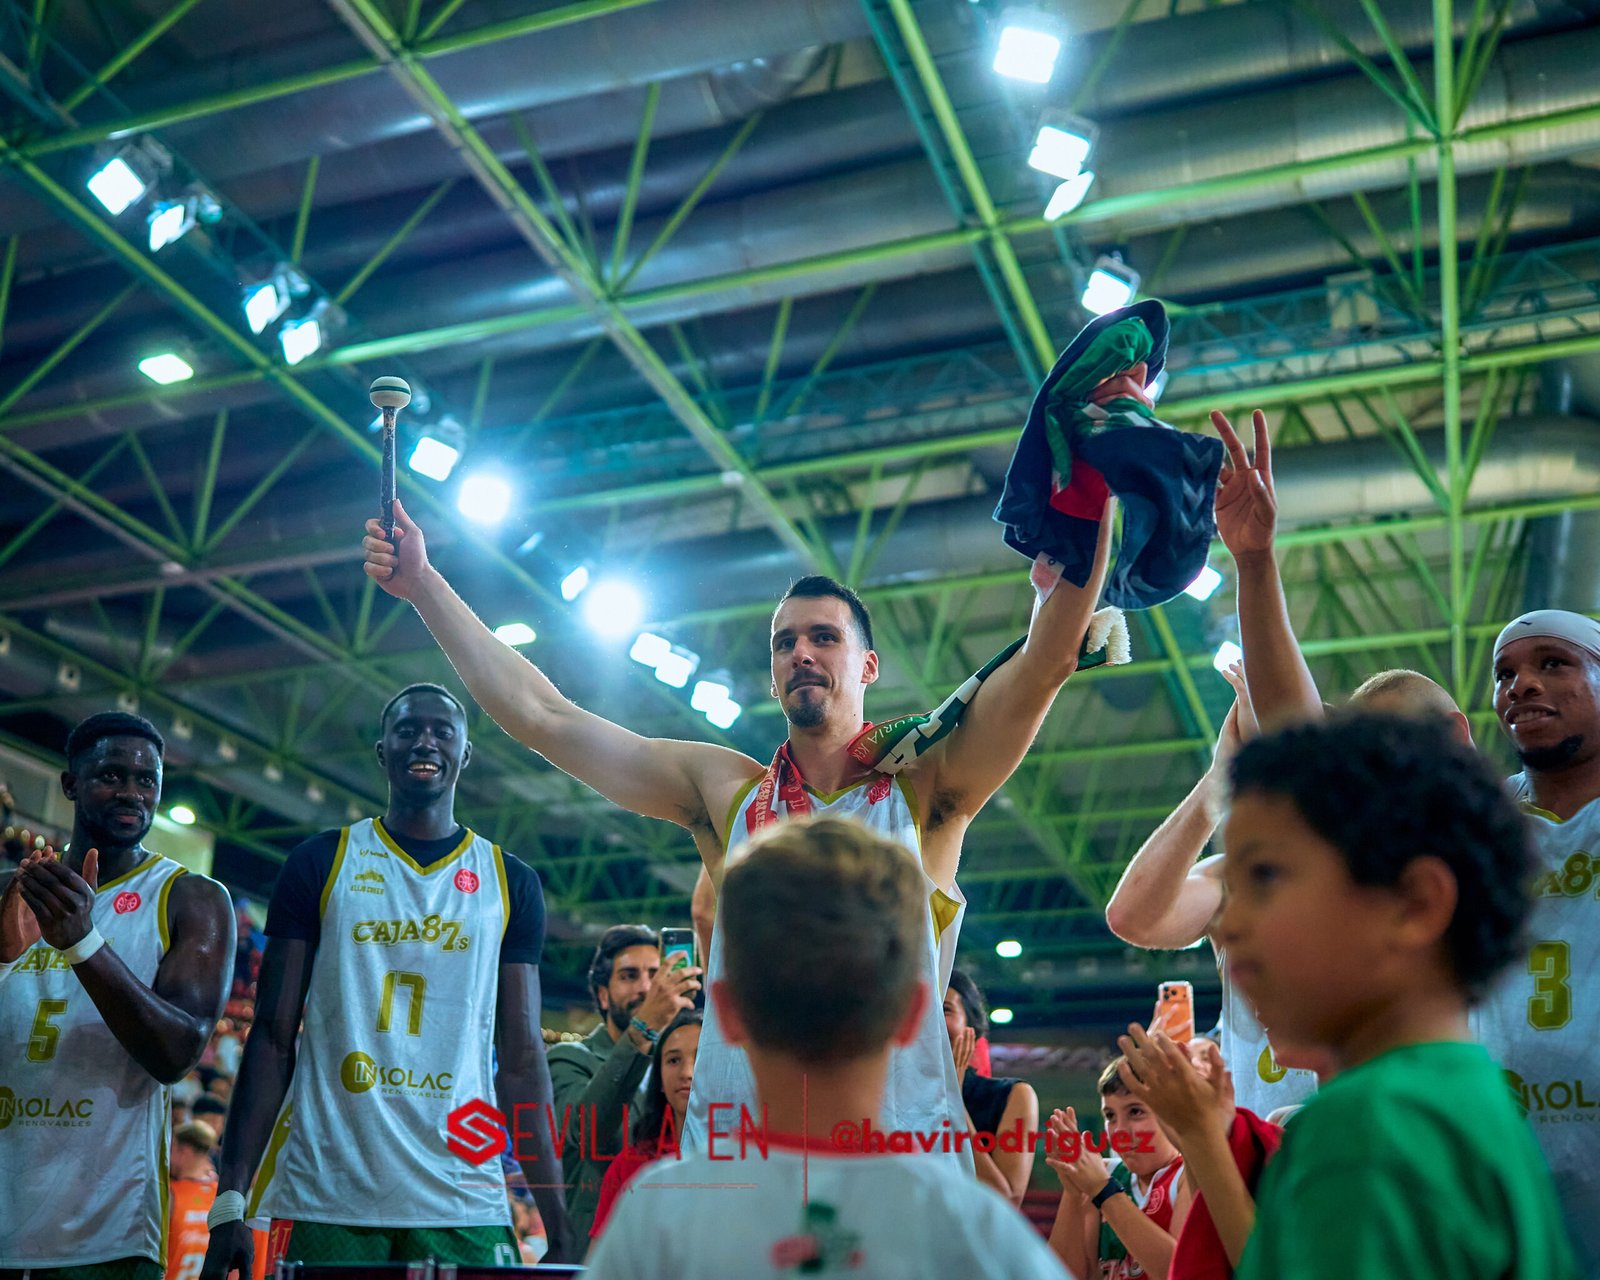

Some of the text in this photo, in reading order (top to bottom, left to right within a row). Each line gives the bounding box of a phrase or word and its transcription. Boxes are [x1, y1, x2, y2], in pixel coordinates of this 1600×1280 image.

[376, 970, 426, 1037] 17
[1527, 940, 1573, 1031] 3
[26, 1000, 68, 1063] 5
[355, 1061, 454, 1091] INSOLAC
[381, 1087, 454, 1100] RENOVABLES
